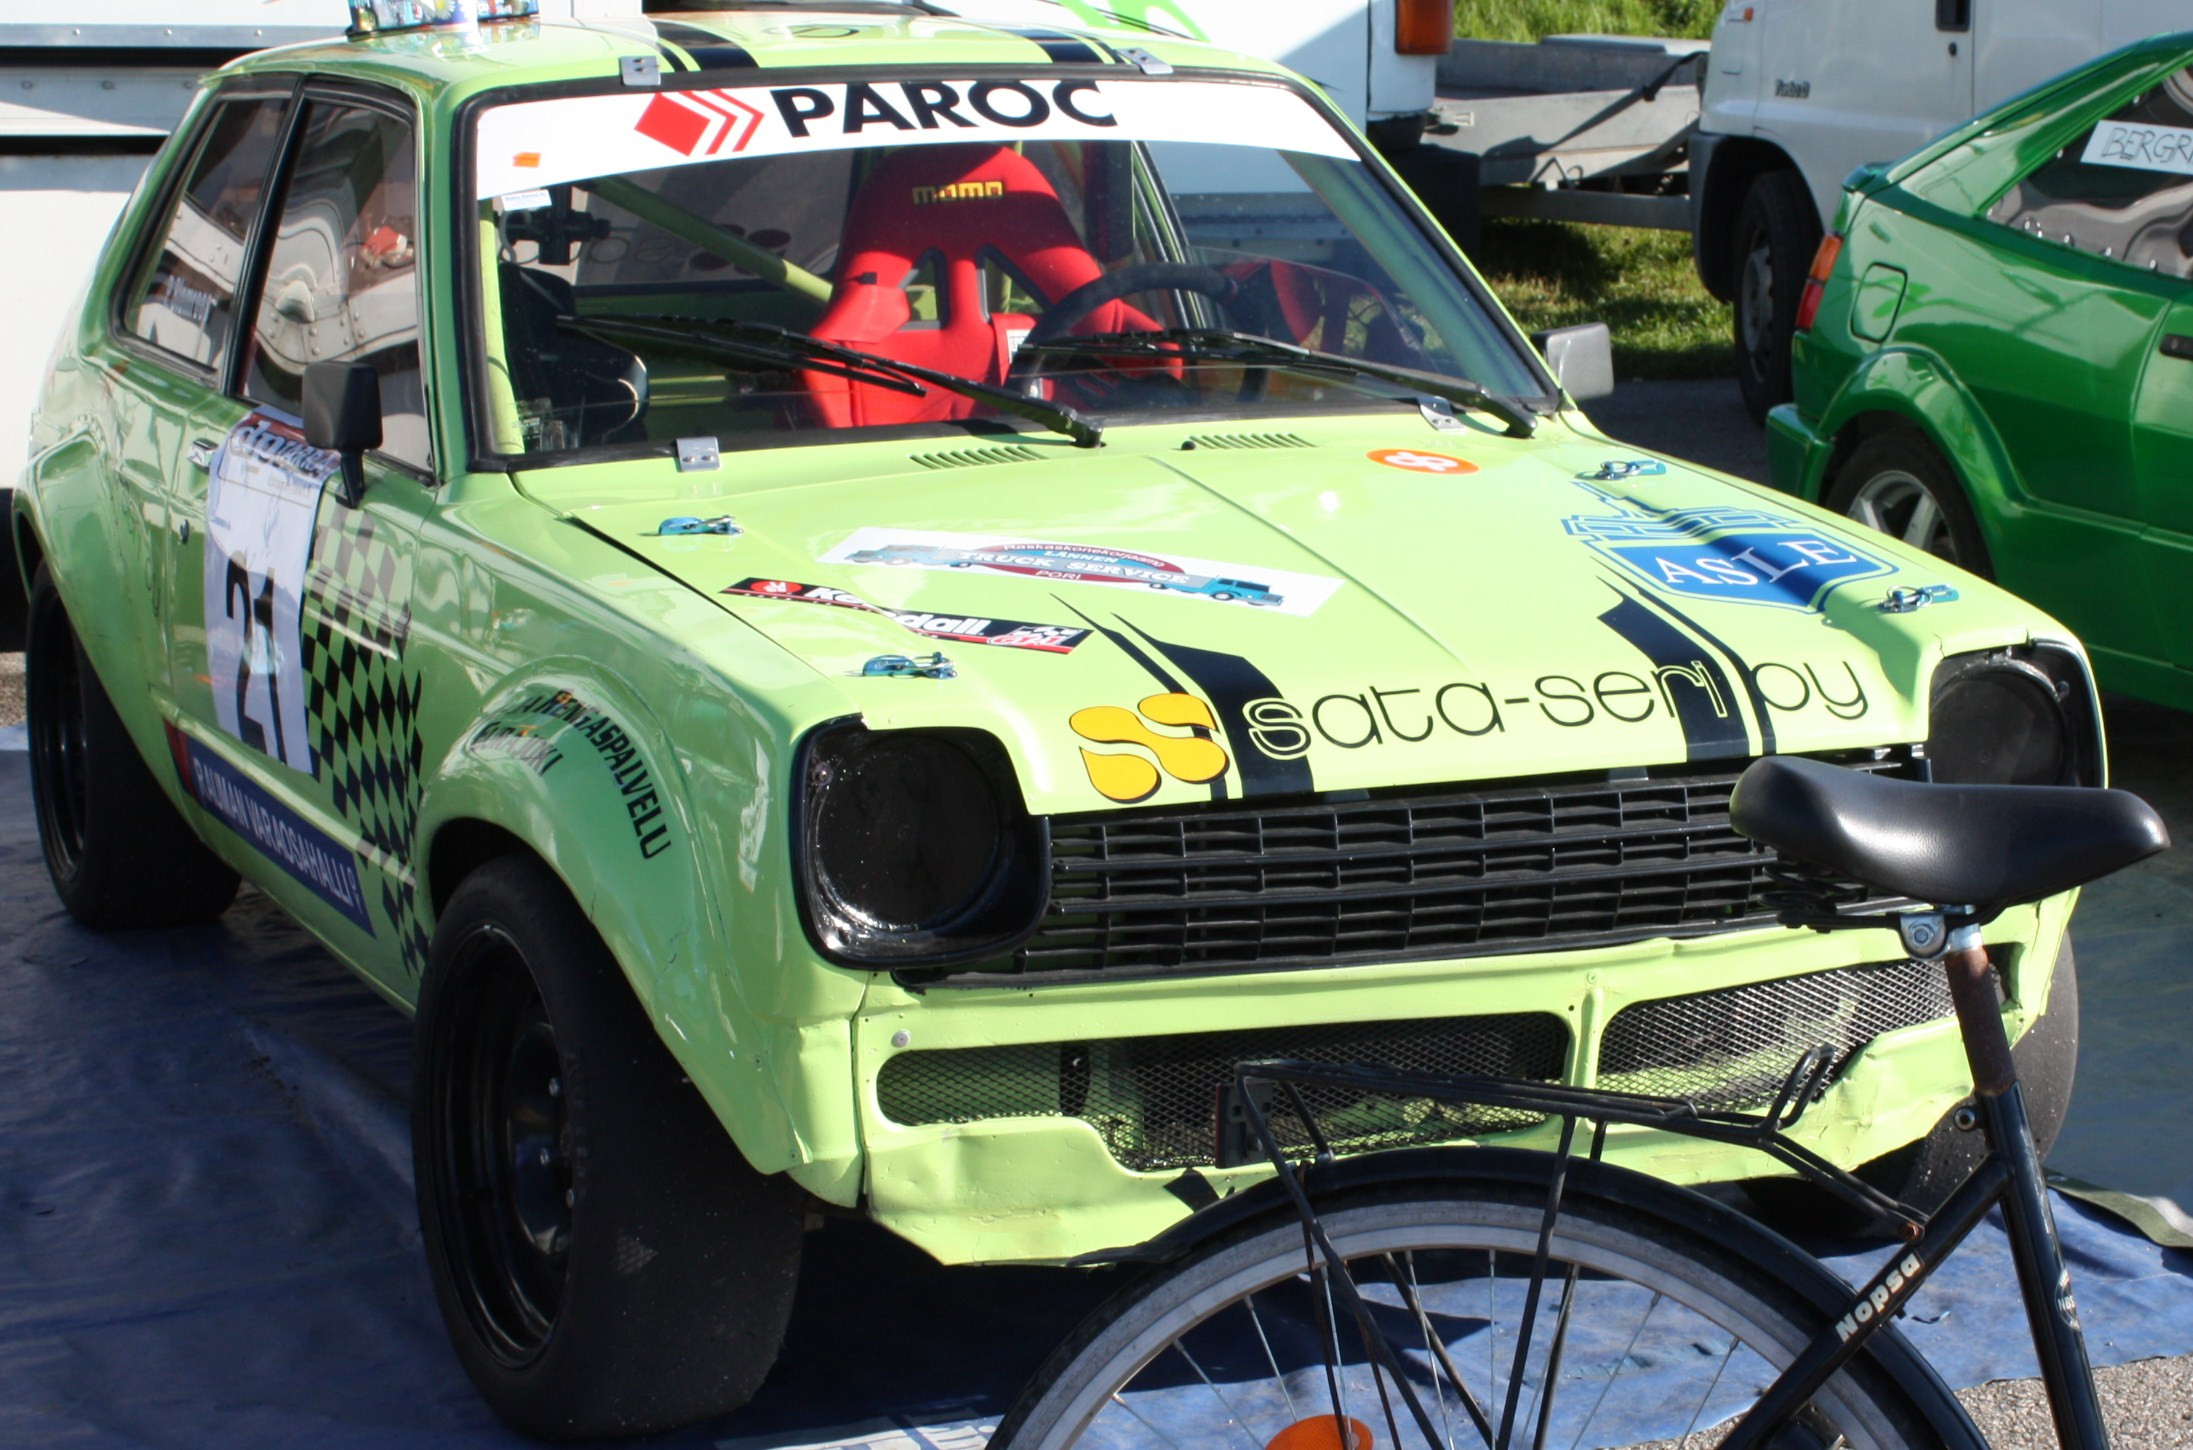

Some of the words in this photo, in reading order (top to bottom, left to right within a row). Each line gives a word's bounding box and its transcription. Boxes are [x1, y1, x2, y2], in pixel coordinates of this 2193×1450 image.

[769, 81, 1119, 138] PAROC
[912, 181, 1003, 204] momo
[958, 551, 1055, 568] TRUCK
[1066, 560, 1191, 584] SERVICE
[1035, 570, 1082, 581] PORI
[1654, 538, 1858, 586] ASLE
[226, 551, 289, 767] 21
[244, 794, 354, 907] VARAOSAHALLI
[1834, 1252, 1922, 1343] Nopsa
